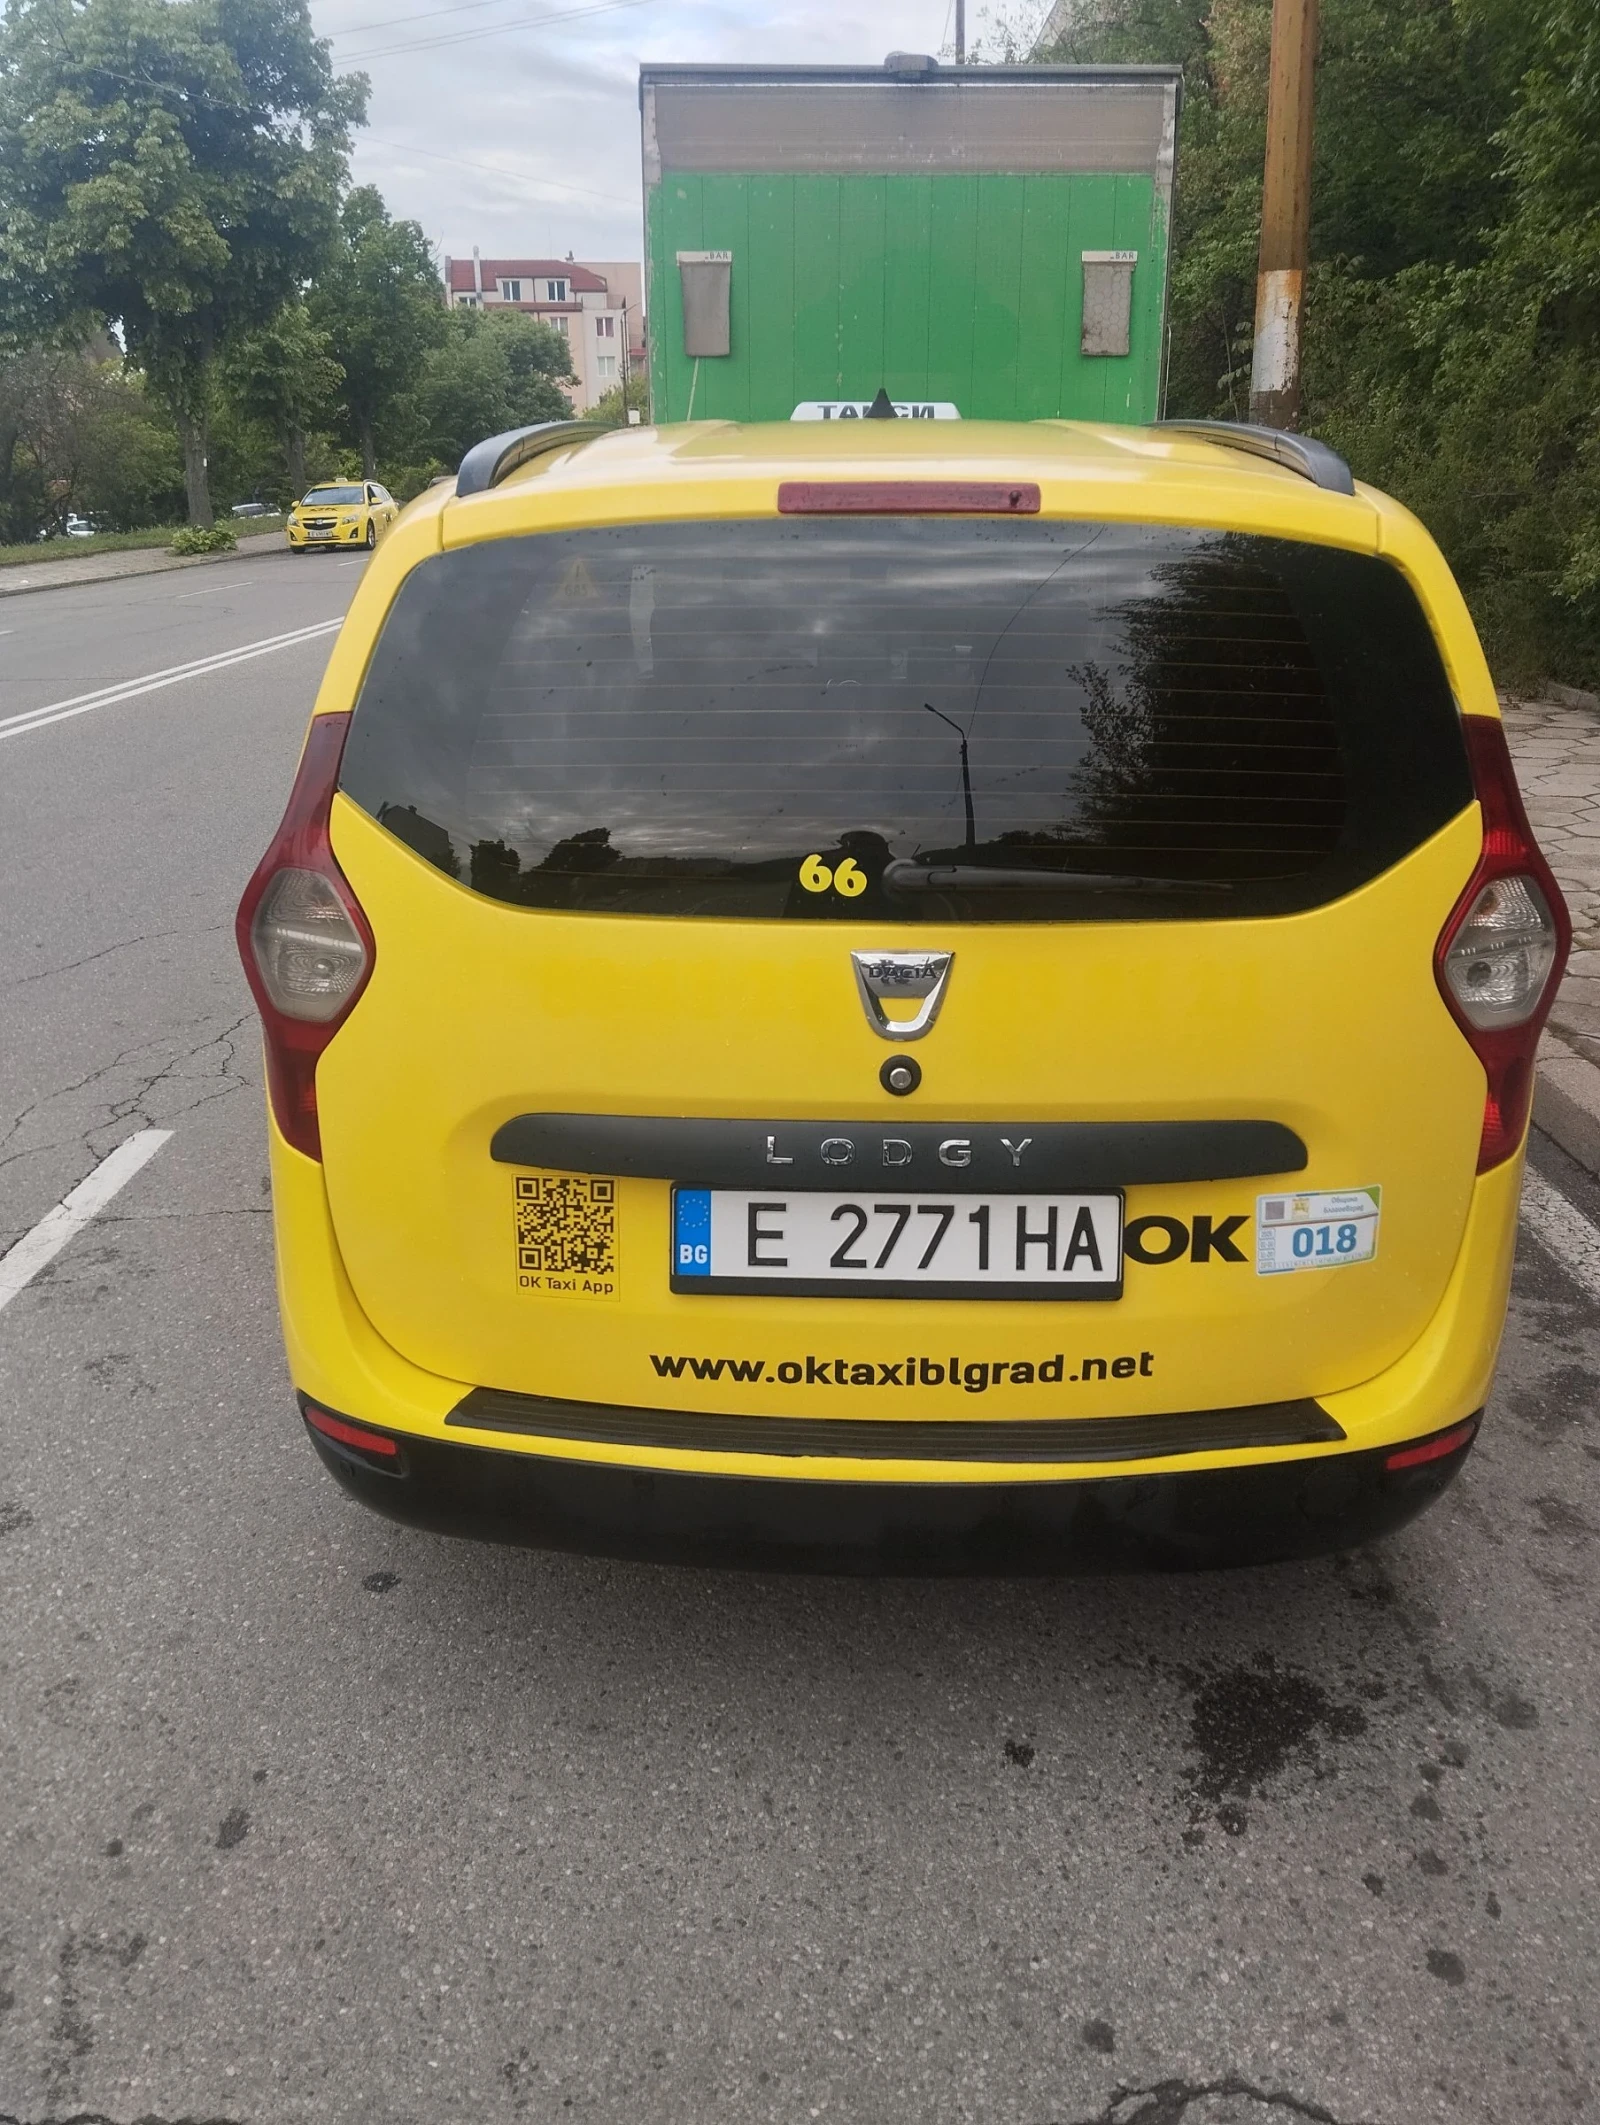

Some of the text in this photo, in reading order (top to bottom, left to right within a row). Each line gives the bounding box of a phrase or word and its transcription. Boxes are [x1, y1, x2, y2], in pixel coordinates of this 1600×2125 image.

[817, 404, 934, 420] ТАСИ
[798, 853, 868, 898] 66
[868, 965, 937, 979] DACIA
[766, 1135, 1033, 1167] LODGY
[747, 1201, 789, 1267] E
[1122, 1215, 1251, 1265] OK
[1292, 1223, 1358, 1258] 018
[679, 1243, 708, 1264] BG
[519, 1275, 614, 1295] OK Taxi App
[649, 1351, 1156, 1393] www.oktaxiblgrad.net
